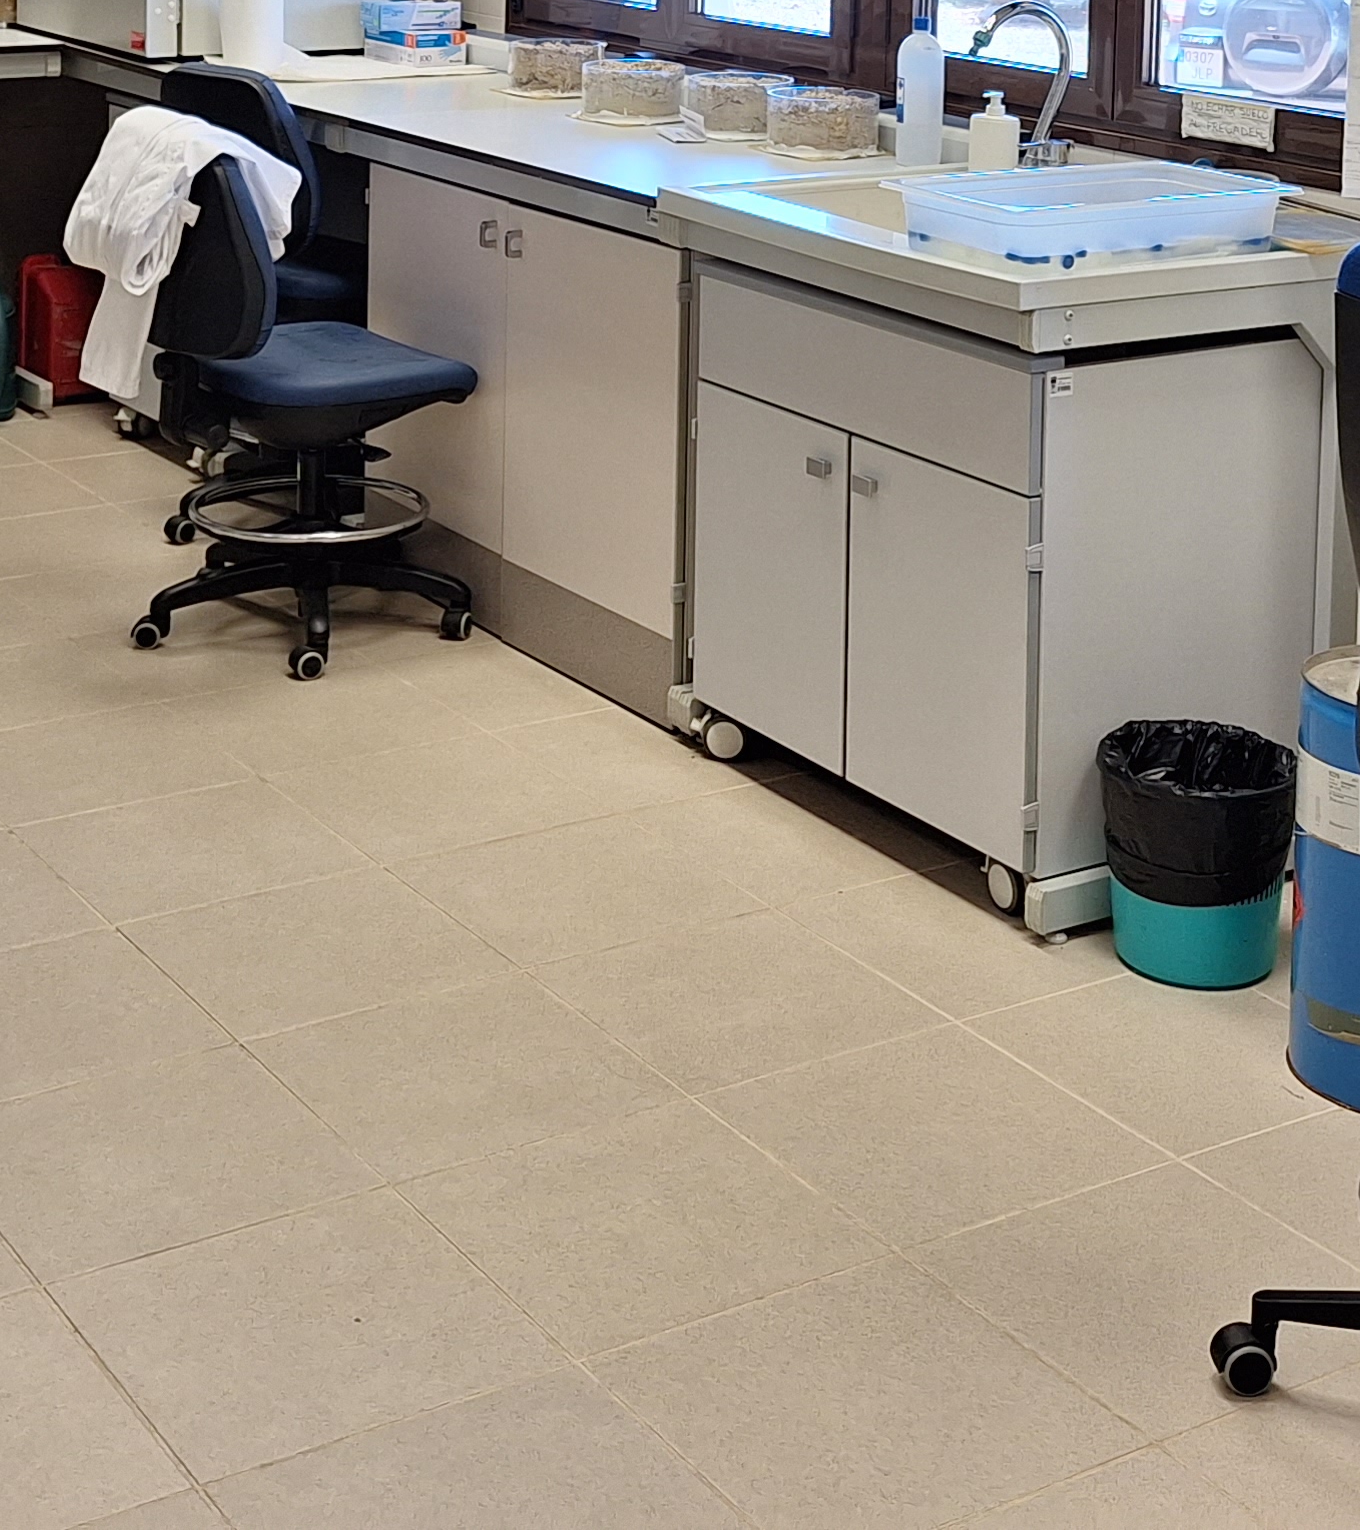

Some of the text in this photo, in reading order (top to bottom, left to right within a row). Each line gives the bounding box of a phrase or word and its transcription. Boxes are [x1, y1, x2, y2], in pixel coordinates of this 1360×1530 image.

[1185, 50, 1214, 64] 0307
[1192, 67, 1213, 80] JLP
[1191, 100, 1269, 120] NO ECHAR SUELO
